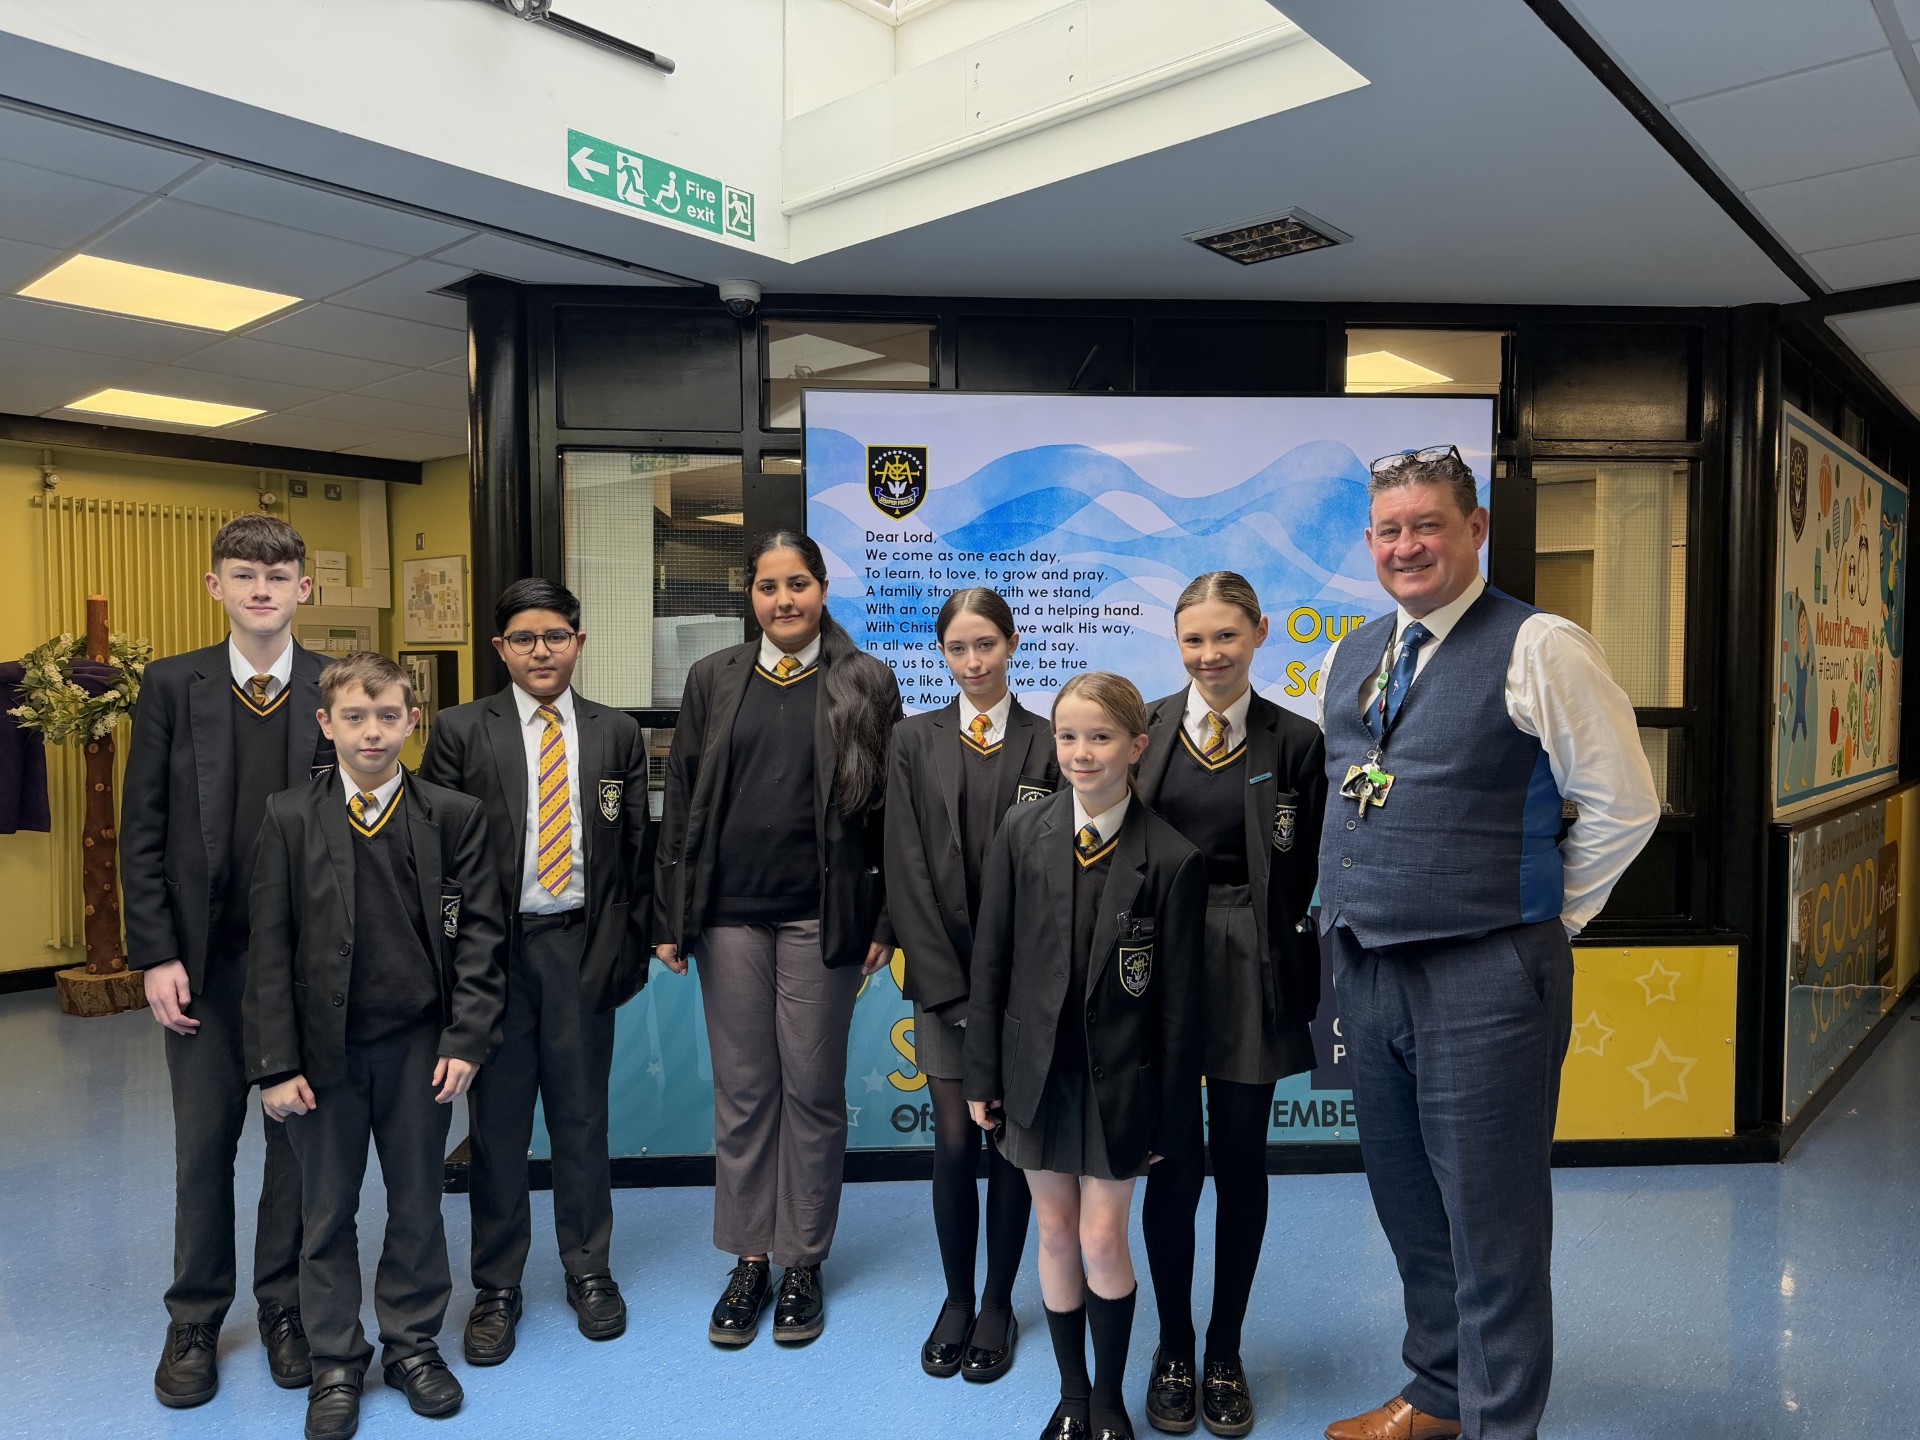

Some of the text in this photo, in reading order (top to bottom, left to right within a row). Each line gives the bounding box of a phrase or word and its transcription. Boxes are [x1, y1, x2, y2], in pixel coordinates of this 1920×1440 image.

[686, 180, 716, 204] Fire
[686, 204, 716, 225] exit
[865, 531, 937, 544] Dear Lord,
[865, 549, 1060, 565] We come as one each day,
[865, 567, 1109, 583] To learn, to love, to grow and pray.
[865, 585, 876, 597] A
[880, 585, 923, 600] family
[994, 585, 1024, 598] faith
[1028, 588, 1049, 599] we
[1052, 586, 1095, 600] stand,
[865, 603, 1144, 619] With an op nd a helping hand.
[865, 621, 895, 633] With
[1017, 624, 1037, 634] we
[1041, 622, 1074, 634] walk
[1078, 622, 1098, 634] His
[1101, 625, 1134, 638] way,
[1286, 606, 1366, 643] Our
[1815, 612, 1870, 650] Mount Carmel
[866, 639, 1079, 654] In all we d and say.
[884, 657, 898, 669] lp
[902, 660, 917, 669] us
[920, 657, 934, 669] to
[1039, 657, 1057, 669] be
[1061, 657, 1088, 669] true
[1818, 656, 1850, 681] #TeamMC
[897, 677, 915, 687] ve
[919, 674, 943, 687] like
[1014, 677, 1036, 687] we
[1039, 675, 1062, 687] do.
[901, 695, 915, 705] re
[1827, 838, 1844, 865] very
[1844, 824, 1863, 860] proud
[1879, 881, 1896, 915] Ofsted
[1813, 857, 1875, 969] GOOD
[1810, 939, 1870, 1044] SCHOOL
[1272, 1100, 1358, 1128] EMBE
